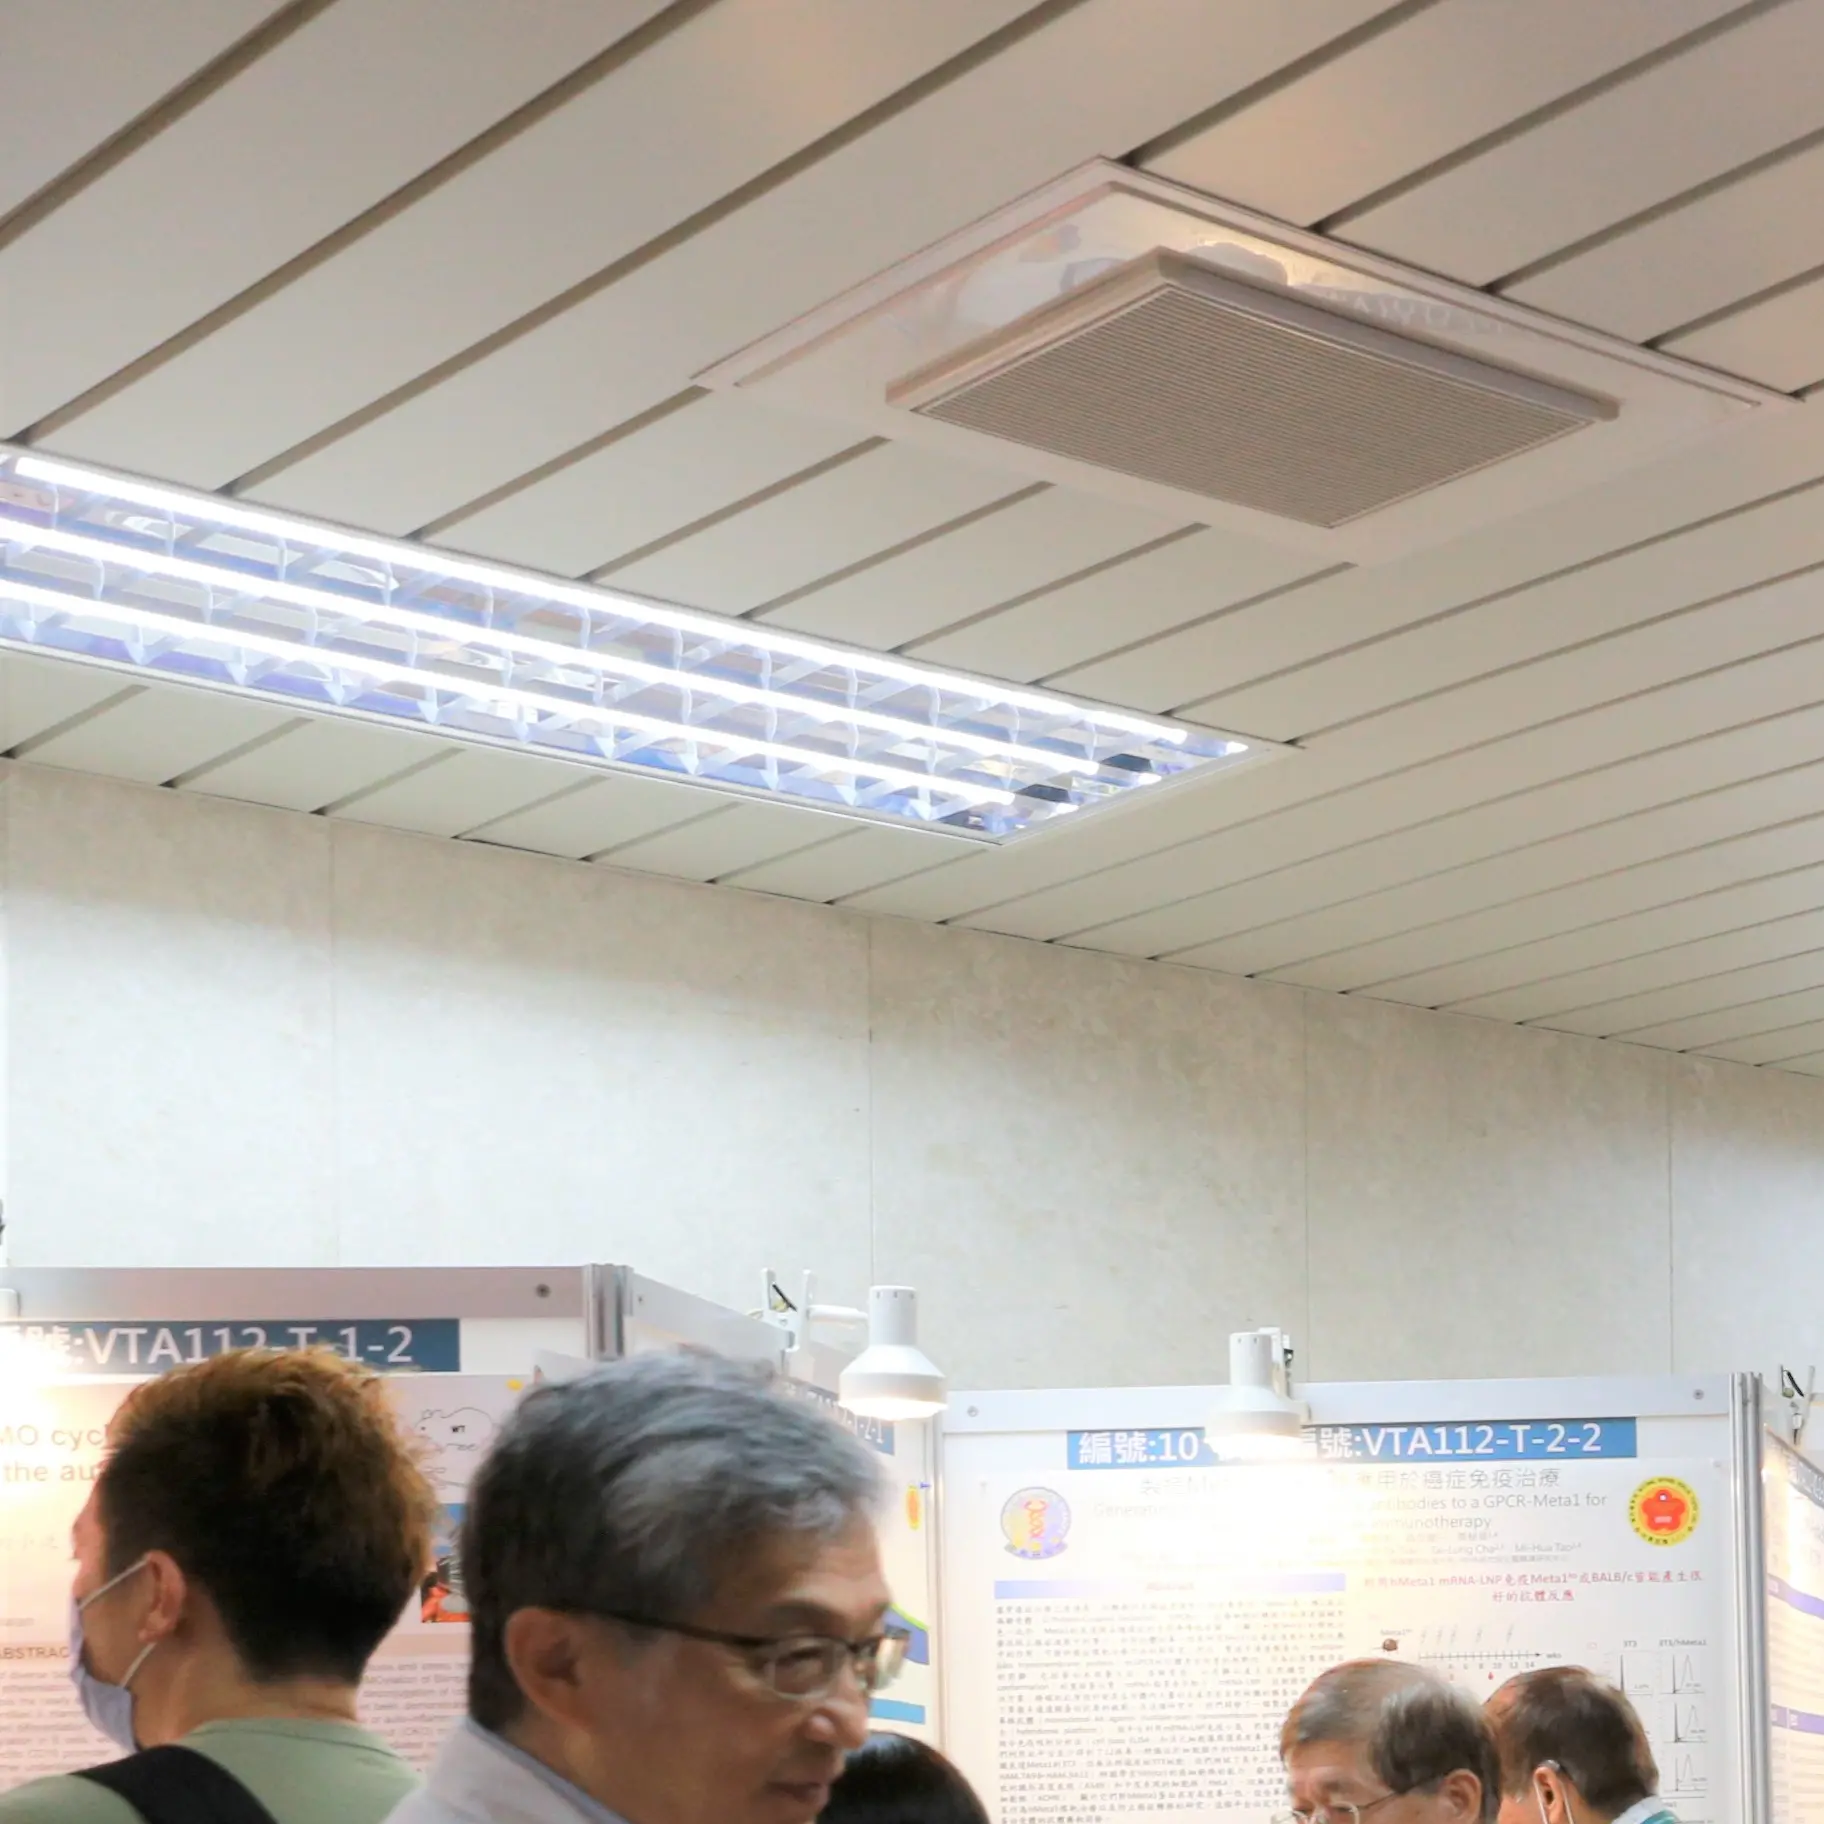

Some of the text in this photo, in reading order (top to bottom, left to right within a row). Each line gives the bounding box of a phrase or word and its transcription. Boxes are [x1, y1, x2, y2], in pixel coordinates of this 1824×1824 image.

[1079, 1432, 1199, 1464] 編號:10
[1452, 1495, 1468, 1509] to
[1471, 1498, 1480, 1509] a
[1483, 1493, 1580, 1509] GPCR-Meta1
[1585, 1492, 1608, 1507] for
[0, 1646, 70, 1660] BSTRAC
